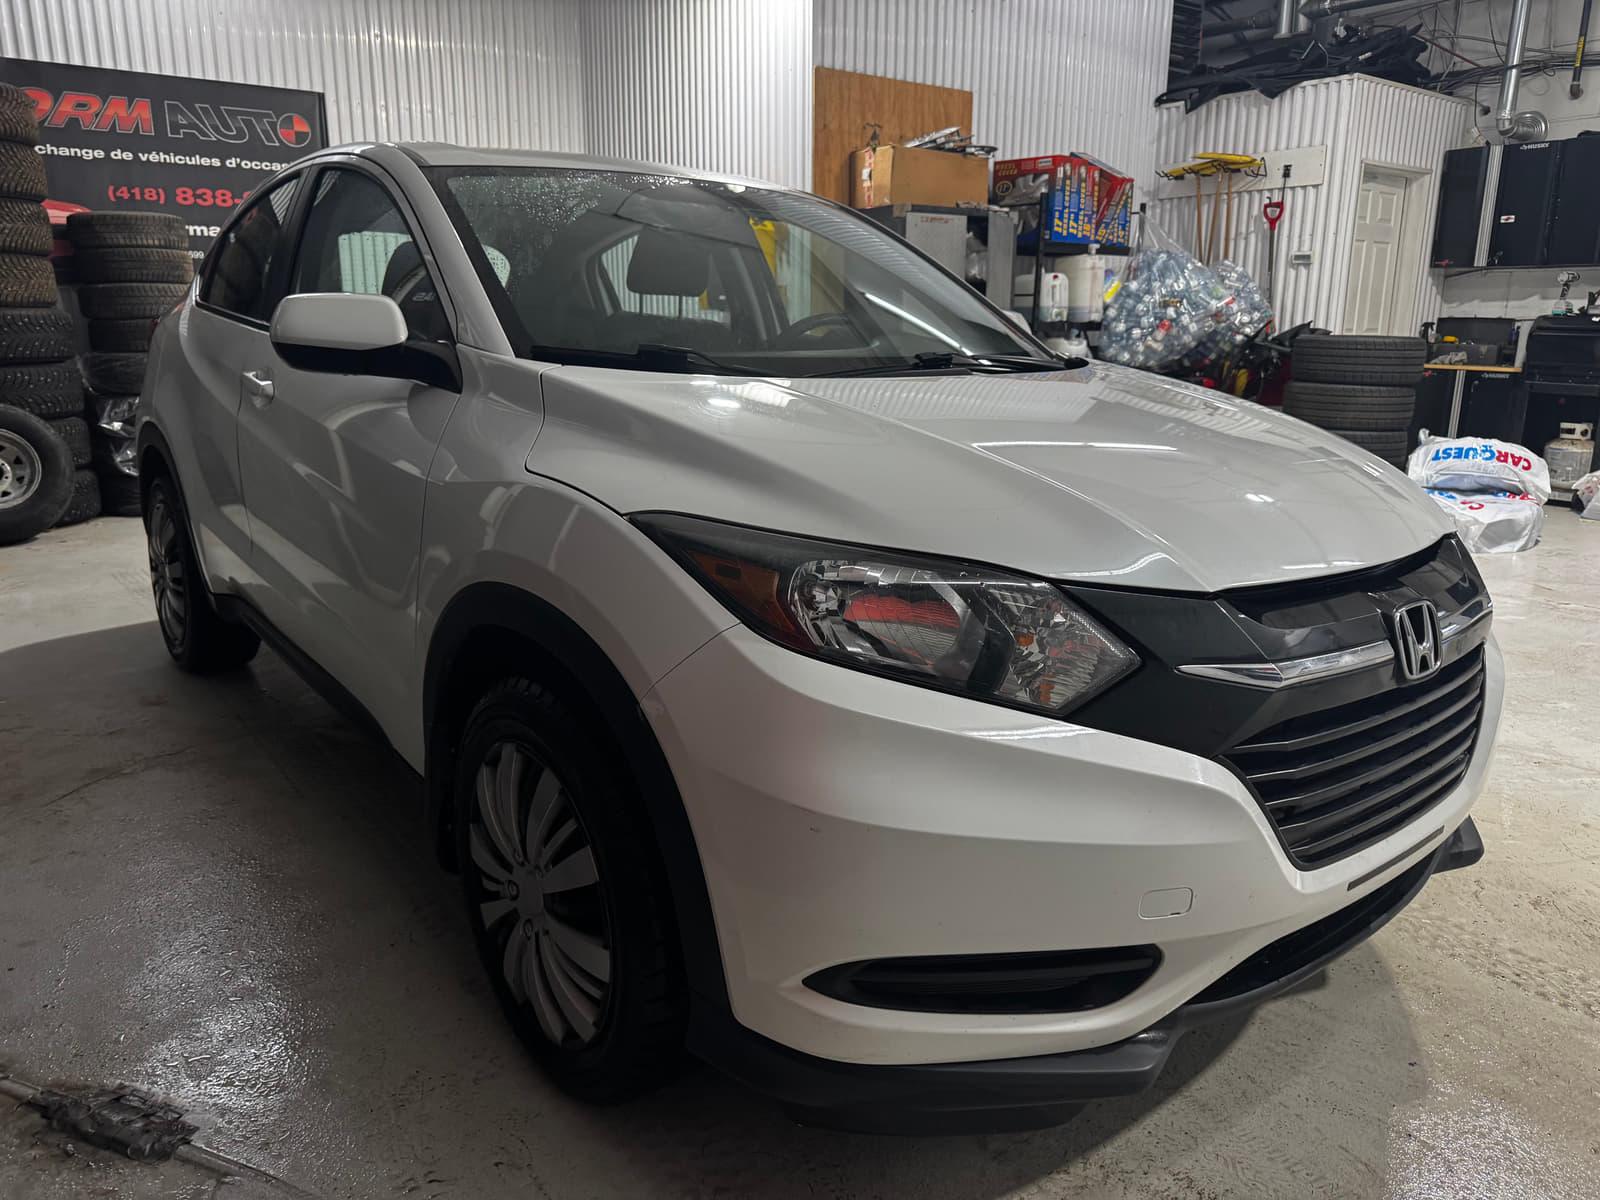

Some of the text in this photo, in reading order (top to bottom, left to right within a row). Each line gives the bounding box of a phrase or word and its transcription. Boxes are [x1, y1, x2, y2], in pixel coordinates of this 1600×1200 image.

[110, 149, 134, 160] de
[138, 152, 221, 167] véhicules
[225, 157, 294, 171] d'occas
[107, 185, 165, 204] (418)
[185, 225, 221, 237] ma
[1431, 444, 1532, 471] CARQUEST
